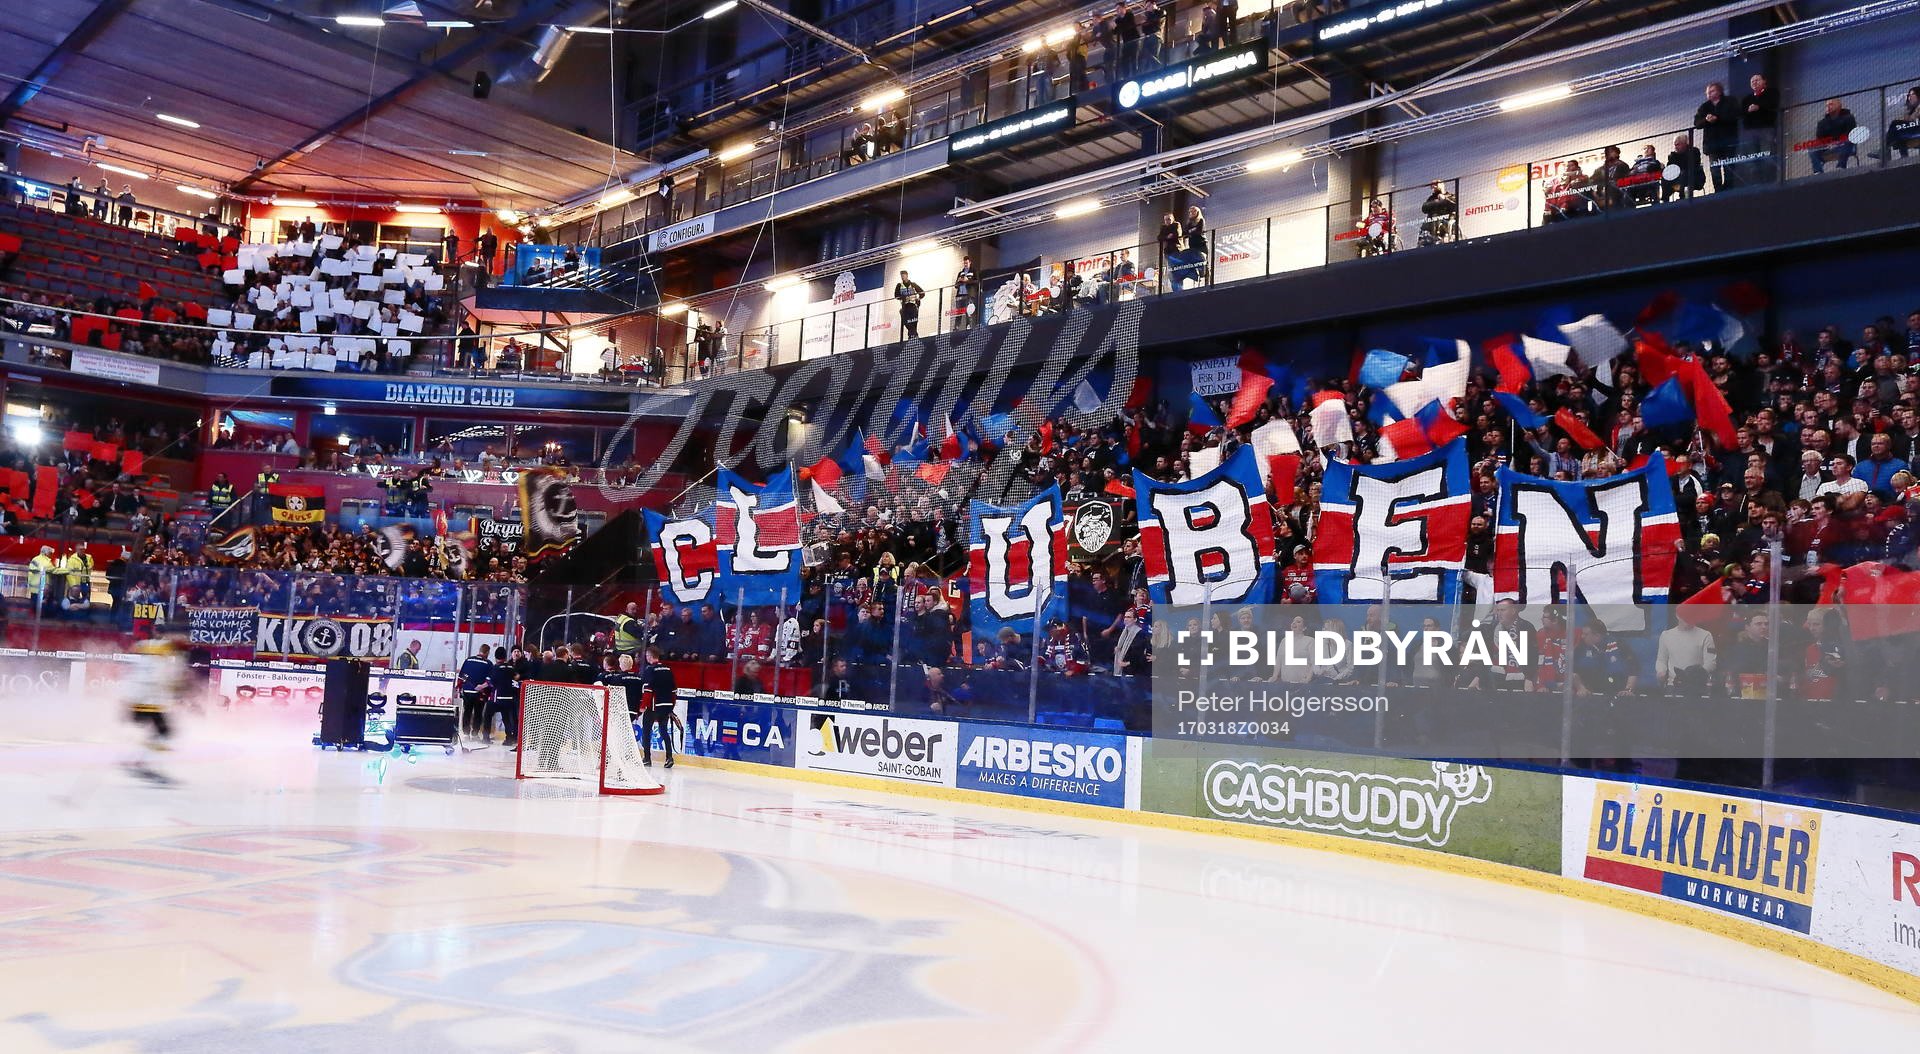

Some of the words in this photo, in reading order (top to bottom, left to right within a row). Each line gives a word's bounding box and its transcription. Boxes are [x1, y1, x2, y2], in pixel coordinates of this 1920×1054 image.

[1193, 51, 1258, 82] ARENA
[669, 222, 705, 244] CONFIGURA
[385, 383, 465, 405] DIAMOND
[470, 387, 515, 407] CLUB
[210, 619, 252, 630] KOMMER
[236, 671, 266, 680] Fönster
[271, 673, 309, 683] Balkonger
[781, 696, 796, 704] ARDEX
[825, 700, 840, 708] ARDEX
[872, 703, 889, 711] ARDEX
[833, 718, 942, 763] weber
[877, 761, 942, 779] SAINT-GOBAIN
[960, 735, 1123, 783] ARBESKO
[978, 771, 1017, 786] MAKES
[1019, 776, 1028, 788] A
[1031, 777, 1100, 796] DIFFERENCE
[1211, 770, 1451, 835] CASHBUDDY
[1597, 793, 1811, 895] BLÅKLÄDER
[1686, 881, 1786, 920] WORKWEAR
[1893, 913, 1920, 949] im
